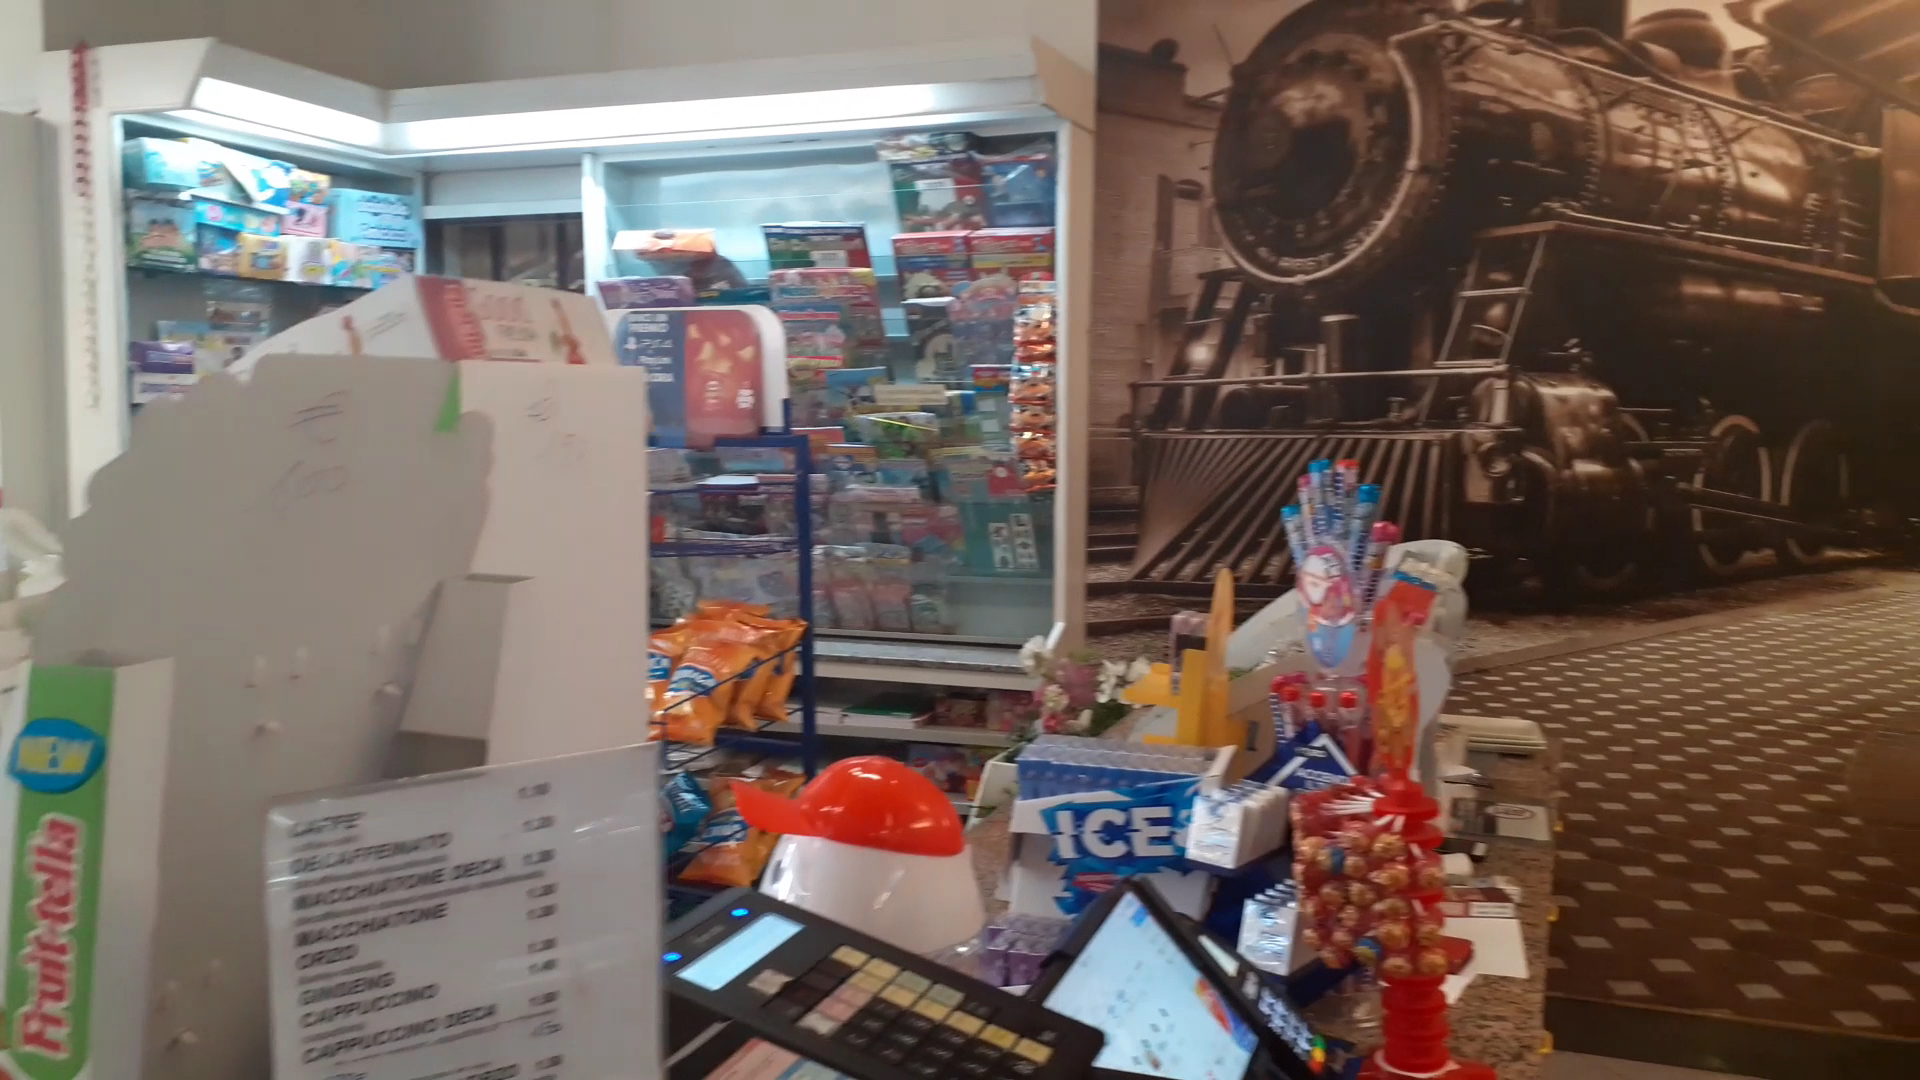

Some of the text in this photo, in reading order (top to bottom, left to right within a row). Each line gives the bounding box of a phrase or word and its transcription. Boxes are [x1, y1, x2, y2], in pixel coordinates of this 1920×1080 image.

[16, 735, 95, 775] NEW
[289, 832, 453, 874] DECAFFEINATO
[291, 867, 448, 911] MACCHIATONE
[450, 855, 505, 881] DECA
[294, 902, 449, 948] MACCHIATONE
[295, 942, 360, 971] ORZO
[299, 971, 396, 1007] GINSENG
[300, 983, 441, 1029] CAPPUCCINO
[302, 1017, 440, 1065] CAPPUCCINO
[444, 1002, 499, 1030] DECA
